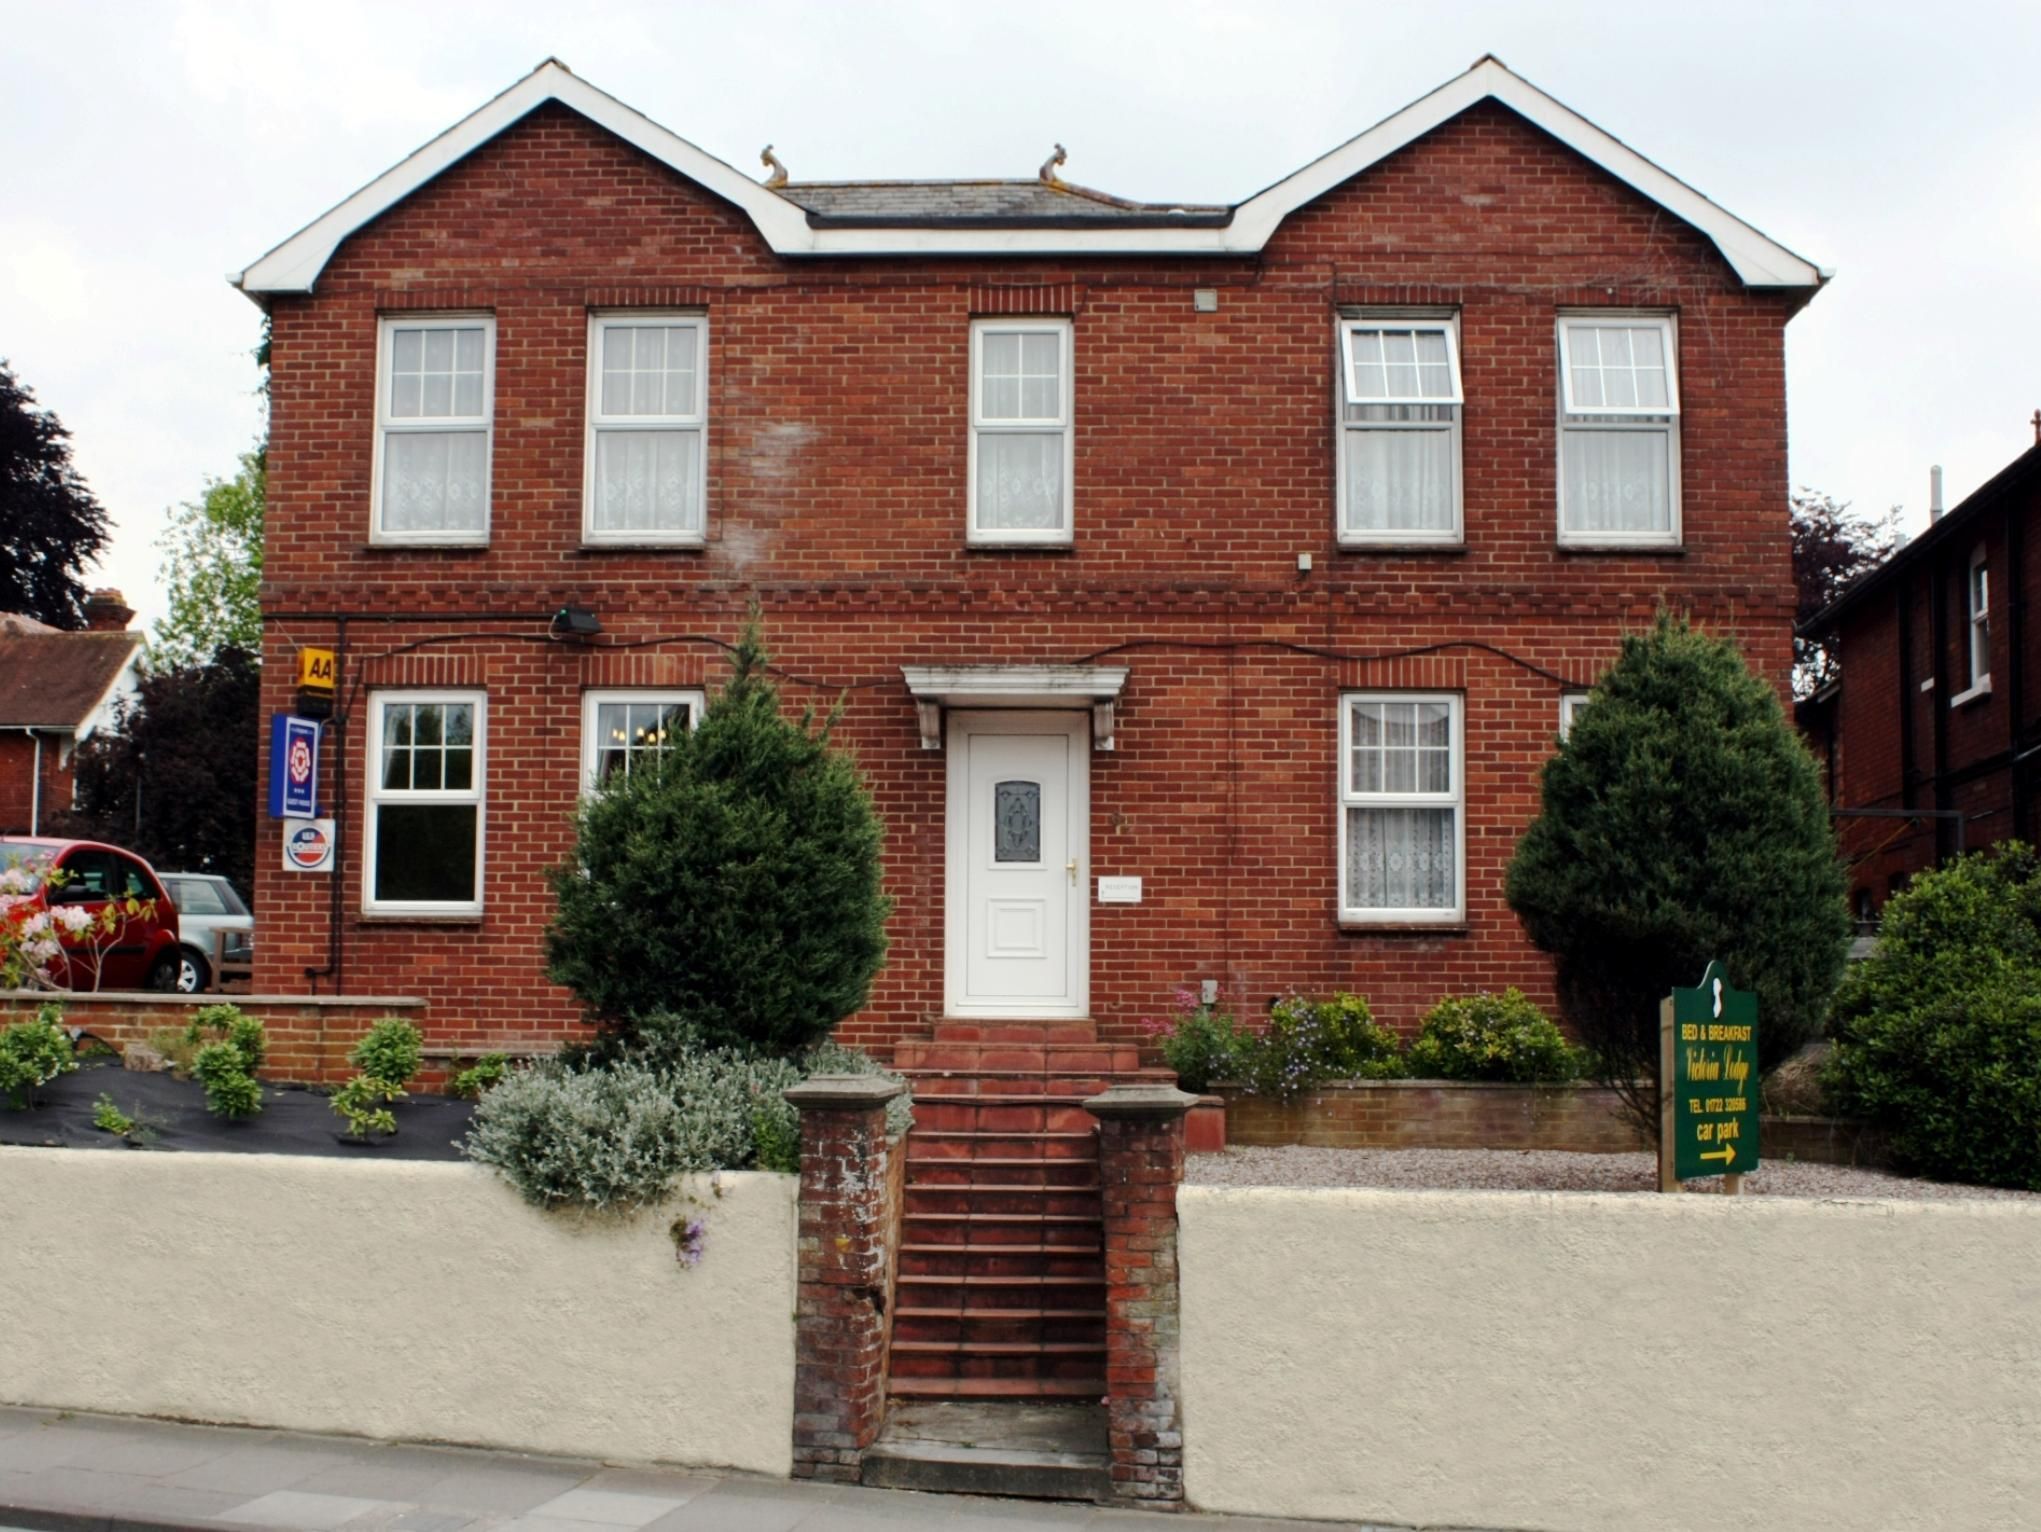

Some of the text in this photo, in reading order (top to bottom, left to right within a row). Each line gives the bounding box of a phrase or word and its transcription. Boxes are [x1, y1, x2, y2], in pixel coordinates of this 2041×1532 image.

[308, 656, 331, 680] AA
[1681, 1023, 1752, 1042] BED & BREAKFAST
[1696, 1116, 1739, 1145] car park
